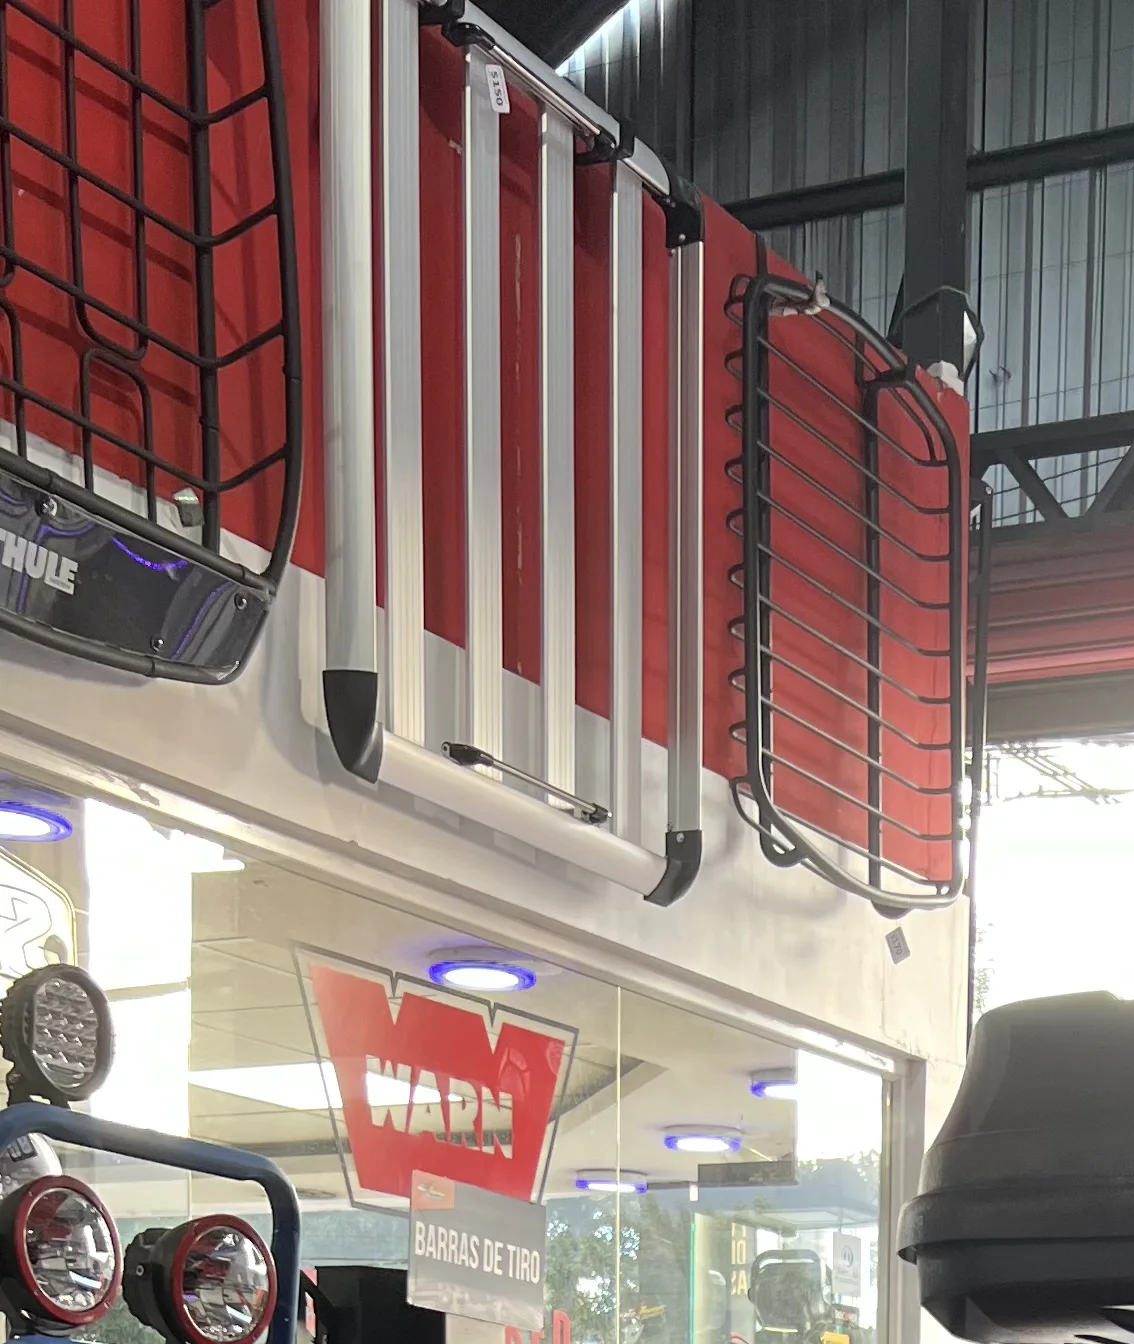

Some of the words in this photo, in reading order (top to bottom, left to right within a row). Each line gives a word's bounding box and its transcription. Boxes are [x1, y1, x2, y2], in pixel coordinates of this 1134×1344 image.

[365, 1053, 513, 1159] WARN
[415, 1220, 480, 1269] BARRAS
[483, 1238, 504, 1275] DE
[507, 1244, 541, 1284] TIRO
